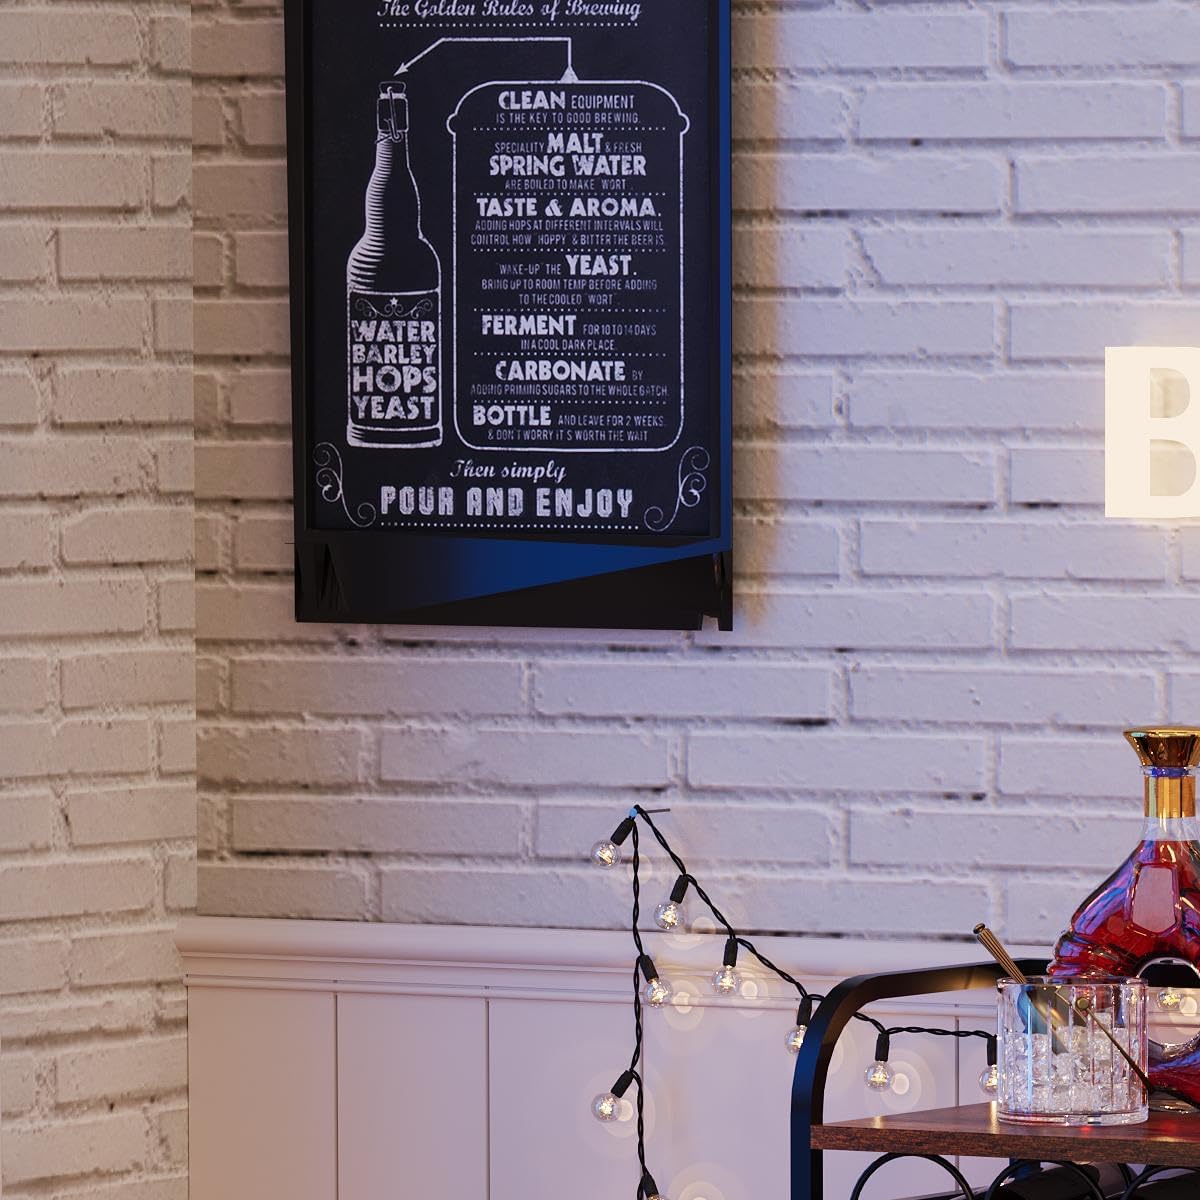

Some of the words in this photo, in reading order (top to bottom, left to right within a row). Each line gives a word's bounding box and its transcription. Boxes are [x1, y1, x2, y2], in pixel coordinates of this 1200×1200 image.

[377, 0, 410, 16] The
[414, 0, 476, 18] Golden
[482, 0, 534, 16] Rules
[541, 0, 559, 21] of
[565, 0, 641, 21] Brewing
[499, 91, 566, 110] CLEAN
[571, 95, 635, 109] EQUIPMENT
[496, 112, 505, 124] IS
[510, 112, 526, 124] THE
[529, 112, 547, 124] KEY
[553, 112, 563, 124] TO
[567, 112, 591, 124] GOOD
[547, 133, 604, 154] MALT
[613, 142, 642, 153] FRESH
[489, 154, 565, 177] SPRING
[572, 154, 647, 177] WATER
[505, 179, 522, 190] ARE
[524, 179, 554, 190] BOILED
[557, 179, 567, 190] TO
[569, 179, 595, 190] MAKE
[476, 198, 537, 217] TASTE
[545, 198, 563, 217] &
[569, 198, 661, 217] AROMA.
[475, 220, 507, 231] ADDING
[509, 220, 532, 231] HOPS
[533, 220, 543, 231] AT
[545, 220, 591, 231] DIFFERENT
[594, 220, 641, 231] INTERVALS
[643, 220, 664, 231] WILL
[471, 234, 510, 246] CONTROL
[512, 234, 531, 246] HOW
[580, 234, 611, 246] BITTER
[613, 234, 629, 246] THE
[631, 234, 653, 246] BEER
[545, 263, 561, 275] THE
[565, 255, 637, 276] YEAST.
[481, 279, 508, 290] BRING
[510, 279, 521, 290] UP
[523, 279, 534, 290] TO
[535, 279, 560, 290] ROOM
[563, 279, 585, 290] TEMP
[588, 279, 622, 290] BEFORE
[624, 279, 657, 290] ADDING
[519, 294, 529, 305] TO
[532, 294, 547, 305] THE
[548, 294, 582, 305] COOLED
[351, 320, 436, 342] WATER
[482, 314, 577, 336] FERMENT
[583, 324, 600, 335] FOR
[612, 324, 623, 335] TO
[634, 324, 657, 335] DAYS
[352, 344, 437, 364] BARLEY
[521, 339, 530, 350] IN
[531, 339, 537, 350] A
[538, 339, 559, 350] COOL
[562, 339, 585, 350] DARK
[353, 365, 437, 393] HOPS
[495, 360, 626, 381] CARBONATE
[632, 370, 643, 381] BY
[542, 384, 577, 396] SUGARS
[578, 384, 589, 396] TO
[590, 384, 606, 396] THE
[608, 384, 637, 396] WHOLE
[352, 395, 435, 419] YEAST
[473, 405, 551, 426] BOTTLE
[557, 415, 576, 425] AND
[577, 415, 604, 425] LEAVE
[606, 415, 623, 425] FOR
[625, 415, 631, 425] 2
[575, 430, 606, 441] WORTH
[608, 430, 624, 441] THE
[450, 459, 496, 478] Then
[501, 460, 567, 484] simply
[381, 486, 454, 516] POUR
[466, 487, 524, 517] AND
[536, 487, 633, 518] ENJOY
